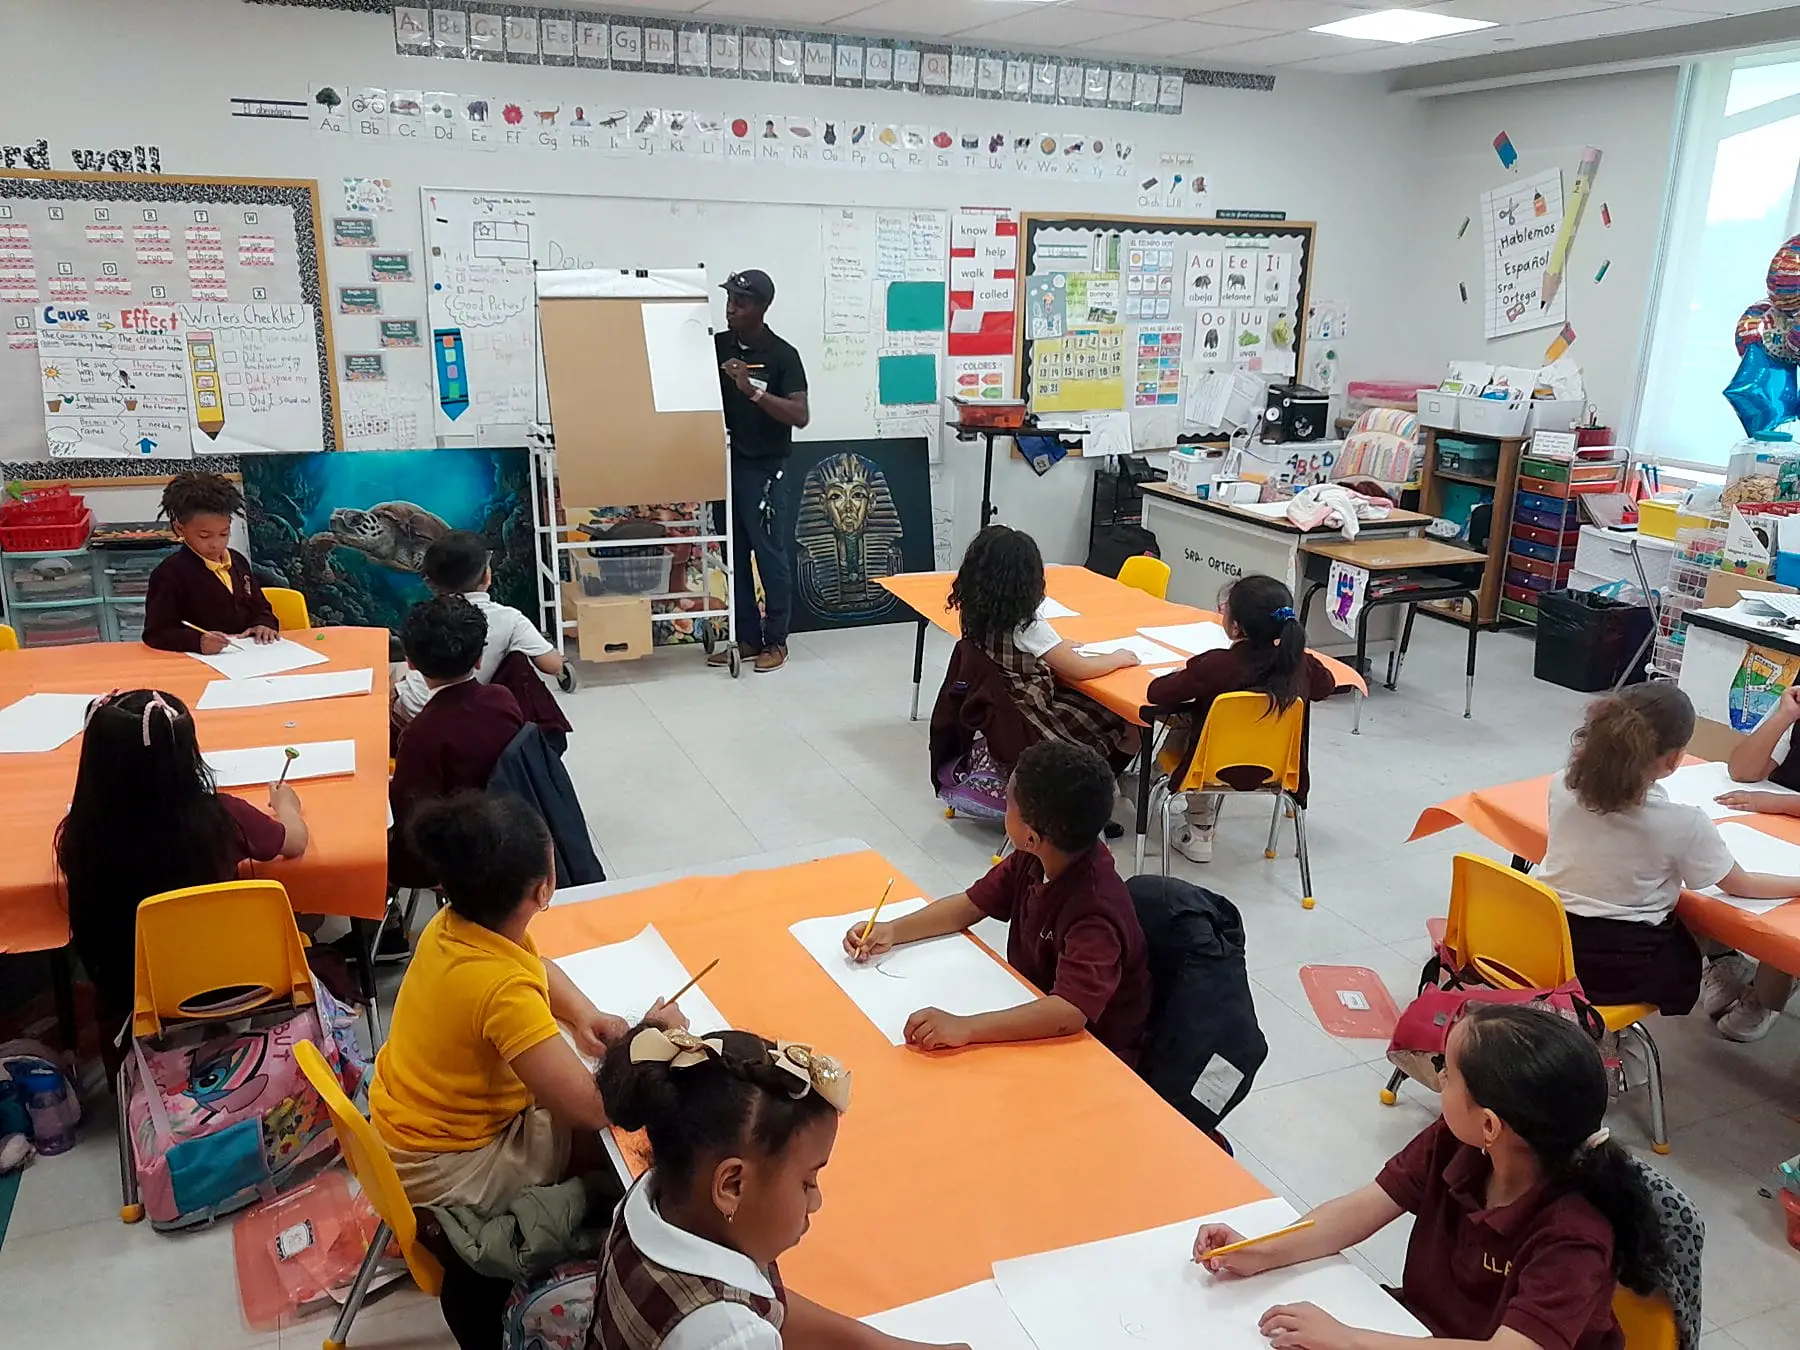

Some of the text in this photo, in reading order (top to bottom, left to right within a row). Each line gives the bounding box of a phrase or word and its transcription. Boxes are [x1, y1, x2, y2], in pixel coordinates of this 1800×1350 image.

[615, 31, 637, 52] Gg
[806, 47, 831, 64] Mm
[840, 50, 858, 66] Nn
[320, 118, 340, 132] Aa
[361, 121, 379, 135] Bb
[399, 124, 416, 137] Cc
[435, 126, 453, 140] Dd
[472, 129, 487, 142] Ee
[506, 130, 520, 144] Ff
[538, 133, 558, 150] Gg
[573, 135, 589, 148] Hh
[639, 138, 654, 156] Jj
[671, 140, 685, 153] Kk
[729, 144, 751, 157] Mm
[763, 146, 779, 158] Nn
[822, 148, 838, 162] Oo
[852, 150, 866, 167] Pp
[0, 139, 161, 174] rd wall
[144, 229, 159, 239] red
[195, 232, 208, 240] the
[960, 225, 988, 235] know
[244, 253, 270, 262] where
[985, 246, 1007, 259] help
[1504, 251, 1550, 280] Español
[961, 268, 985, 278] walk
[60, 281, 79, 291] little
[1497, 283, 1516, 293] Sra.
[1189, 293, 1213, 304] abeja
[1222, 293, 1251, 301] elefante
[1502, 289, 1537, 306] Ortega
[453, 296, 483, 310] Good
[44, 306, 90, 324] Cause
[121, 308, 179, 330] Effect
[119, 335, 132, 344] The
[243, 352, 257, 362] Did
[76, 360, 90, 368] The
[963, 362, 997, 370] COLORES
[246, 373, 260, 385] Did
[249, 393, 265, 405] Did
[1208, 556, 1243, 578] ORTEGA
